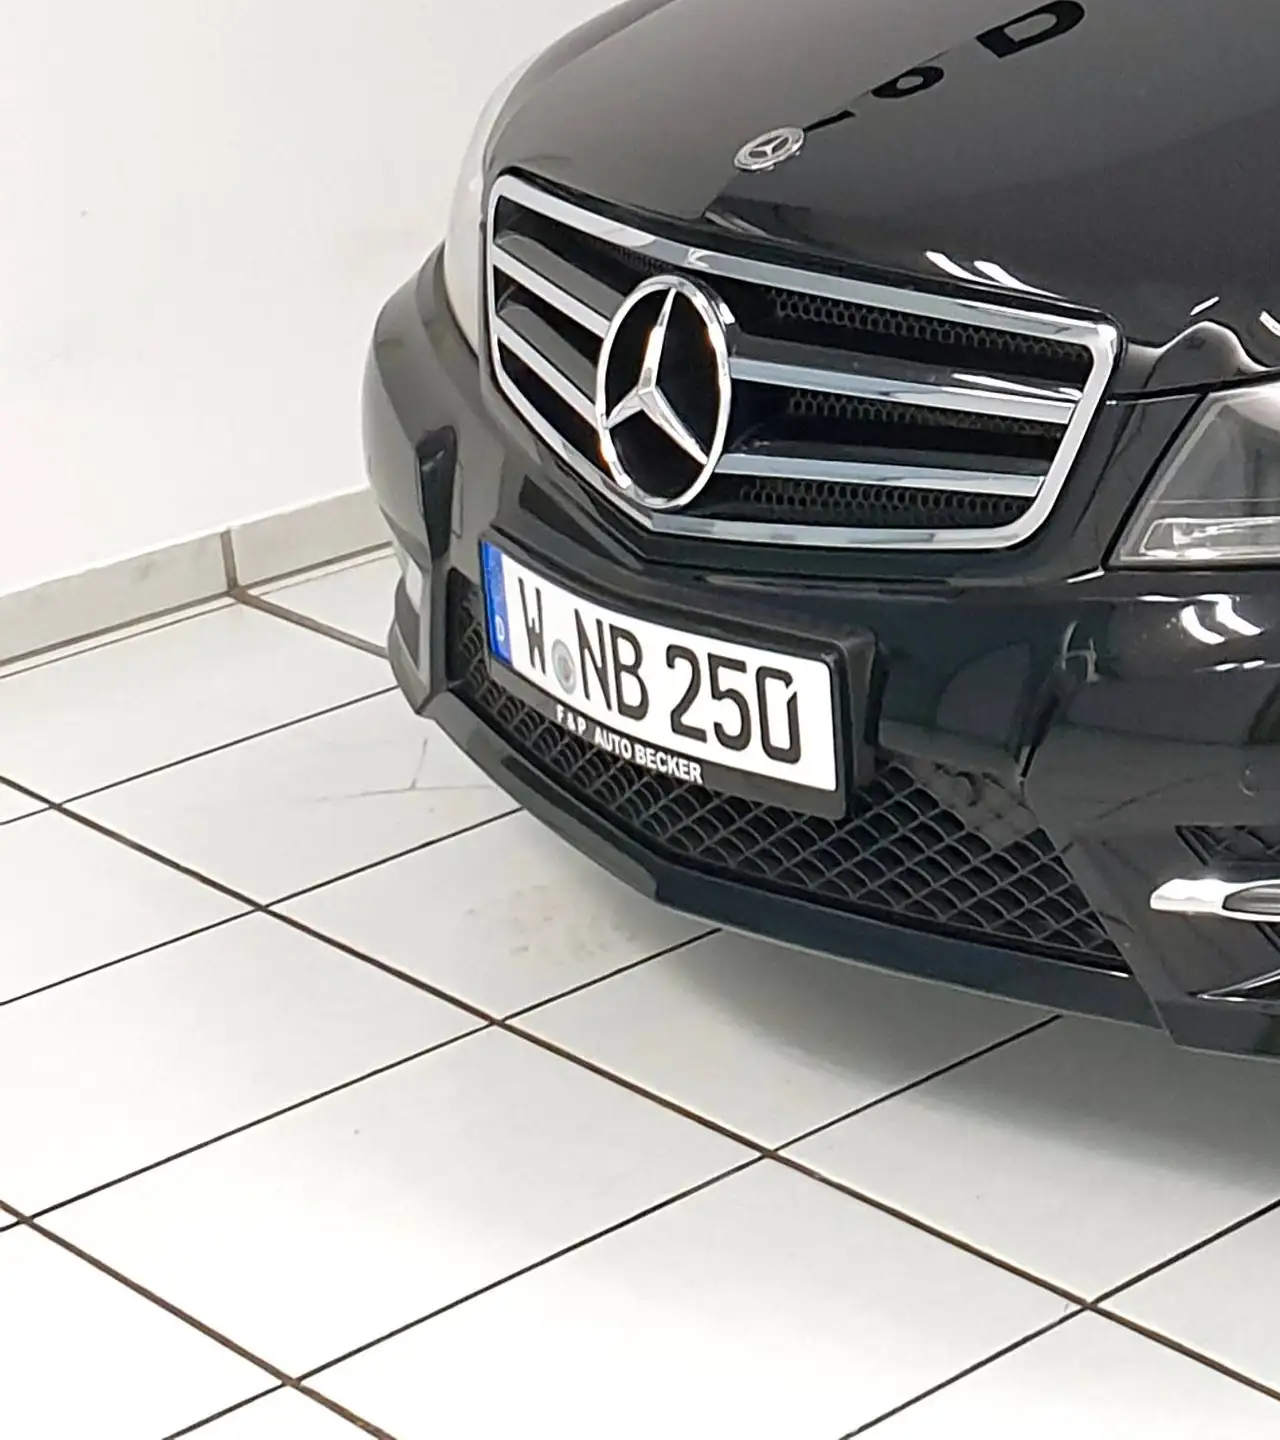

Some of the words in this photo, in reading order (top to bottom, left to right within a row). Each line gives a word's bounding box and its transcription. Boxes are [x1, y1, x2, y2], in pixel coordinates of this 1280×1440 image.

[518, 576, 546, 675] W
[574, 607, 649, 721] NB
[666, 644, 801, 765] 250
[594, 726, 632, 759] AUTO
[634, 743, 703, 784] BECKER
